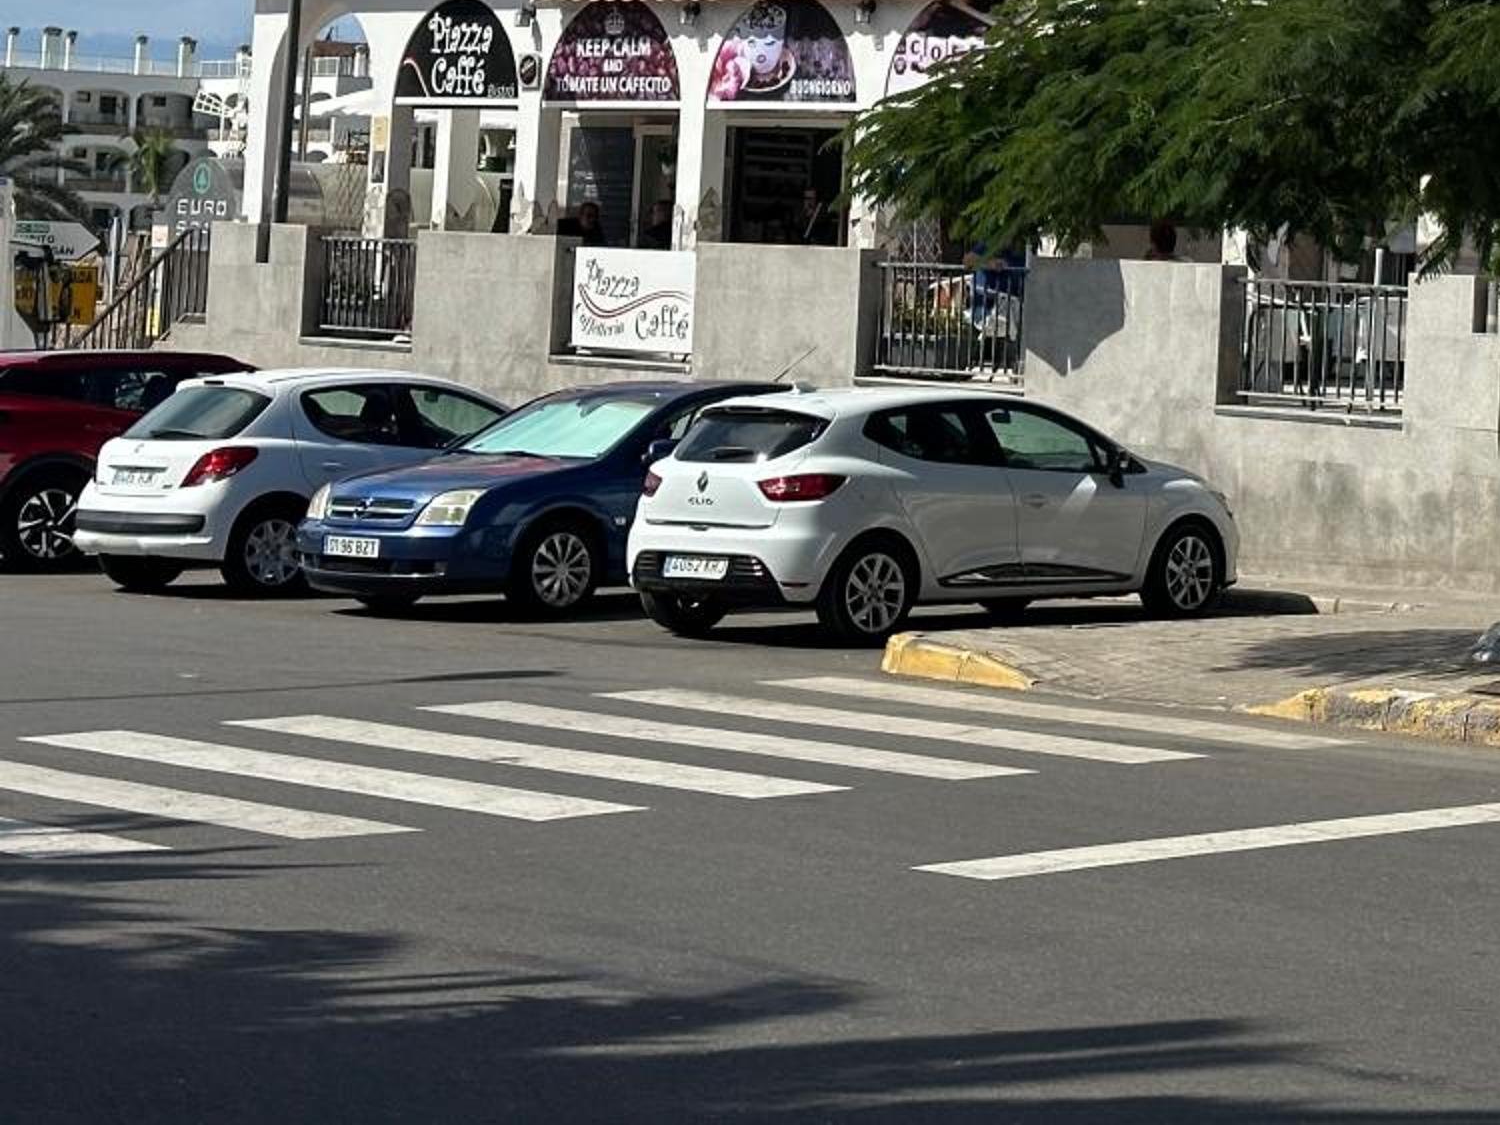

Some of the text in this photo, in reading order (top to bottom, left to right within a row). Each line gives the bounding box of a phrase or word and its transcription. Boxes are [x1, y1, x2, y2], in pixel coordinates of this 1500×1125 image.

[429, 13, 493, 55] Piazza
[577, 37, 651, 57] KEEP CALM
[431, 55, 486, 96] Caffé
[603, 59, 623, 72] AND
[601, 76, 618, 92] UN
[619, 76, 671, 93] CAFECITO
[177, 198, 227, 216] EURO
[585, 258, 640, 299] Piazza
[635, 304, 689, 340] Caffé
[688, 497, 714, 506] CLIO
